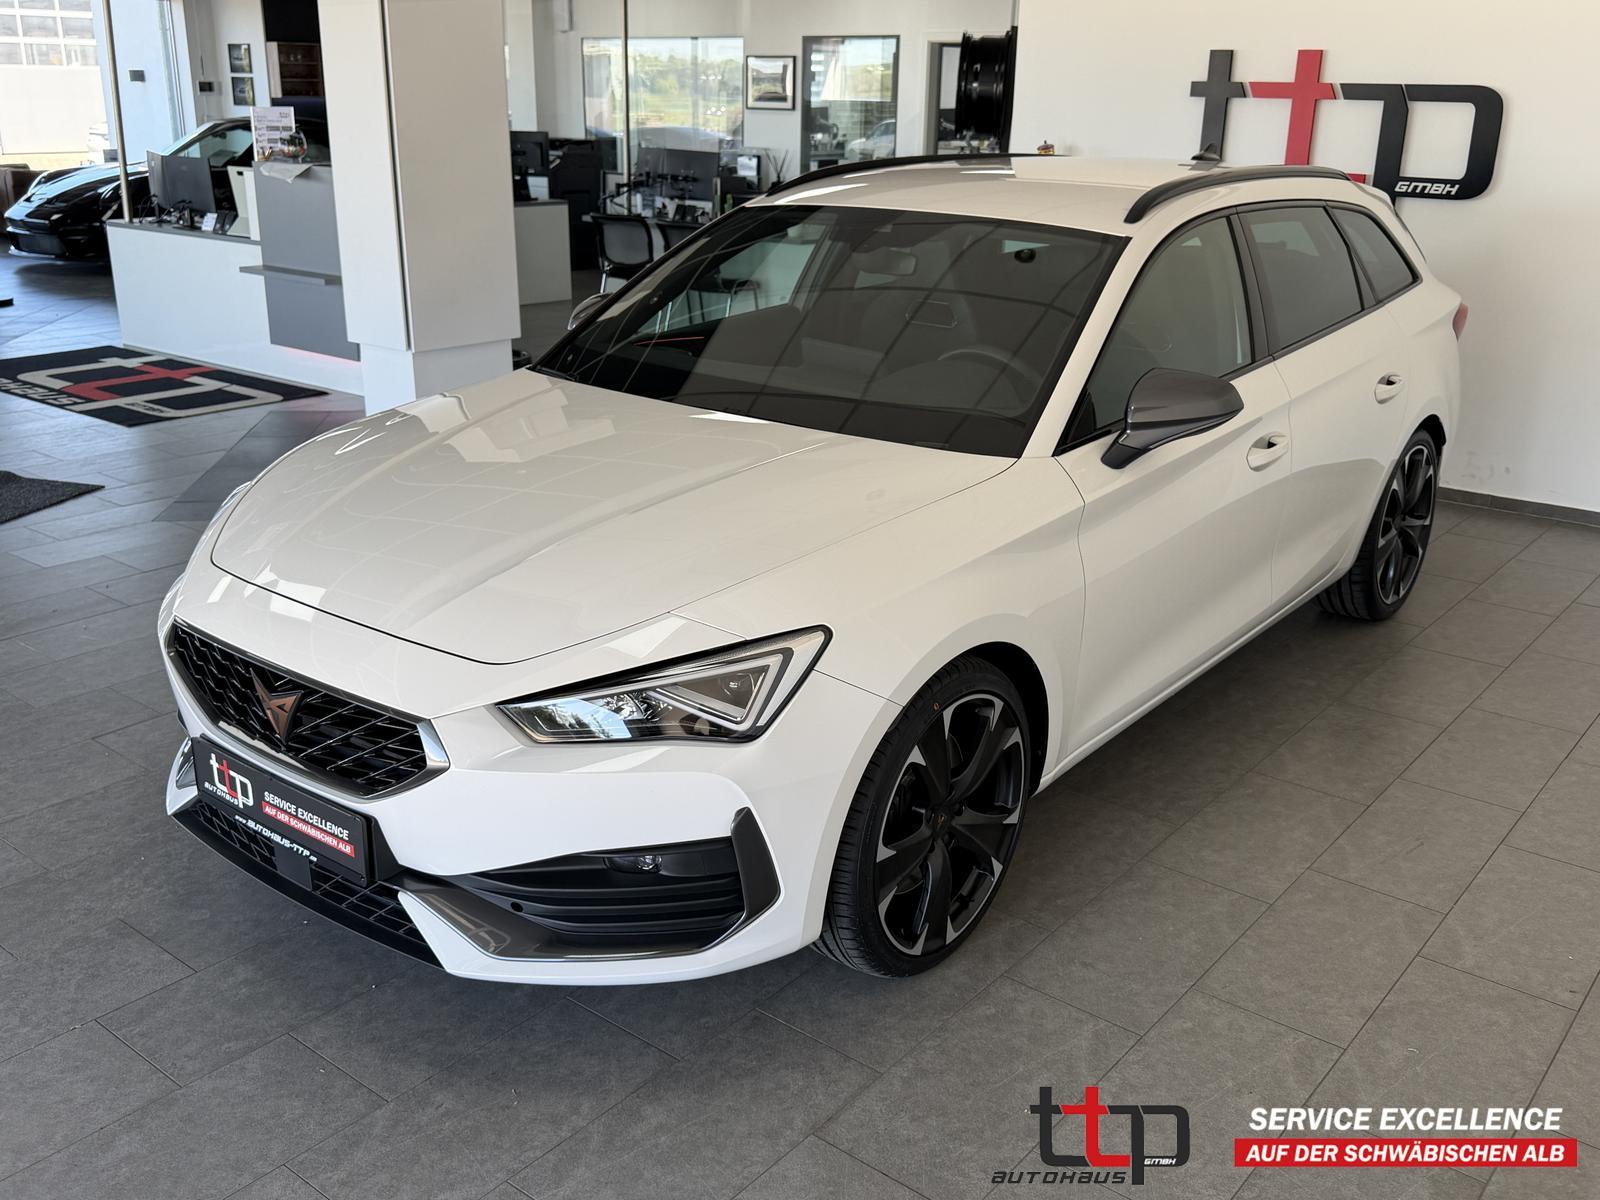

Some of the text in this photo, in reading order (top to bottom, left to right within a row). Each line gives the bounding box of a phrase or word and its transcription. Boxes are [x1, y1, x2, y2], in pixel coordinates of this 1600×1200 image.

[264, 791, 350, 840] SERVICE EXCELLENCE
[265, 805, 352, 853] AUF DER SCHWÄBISCHEN ALB
